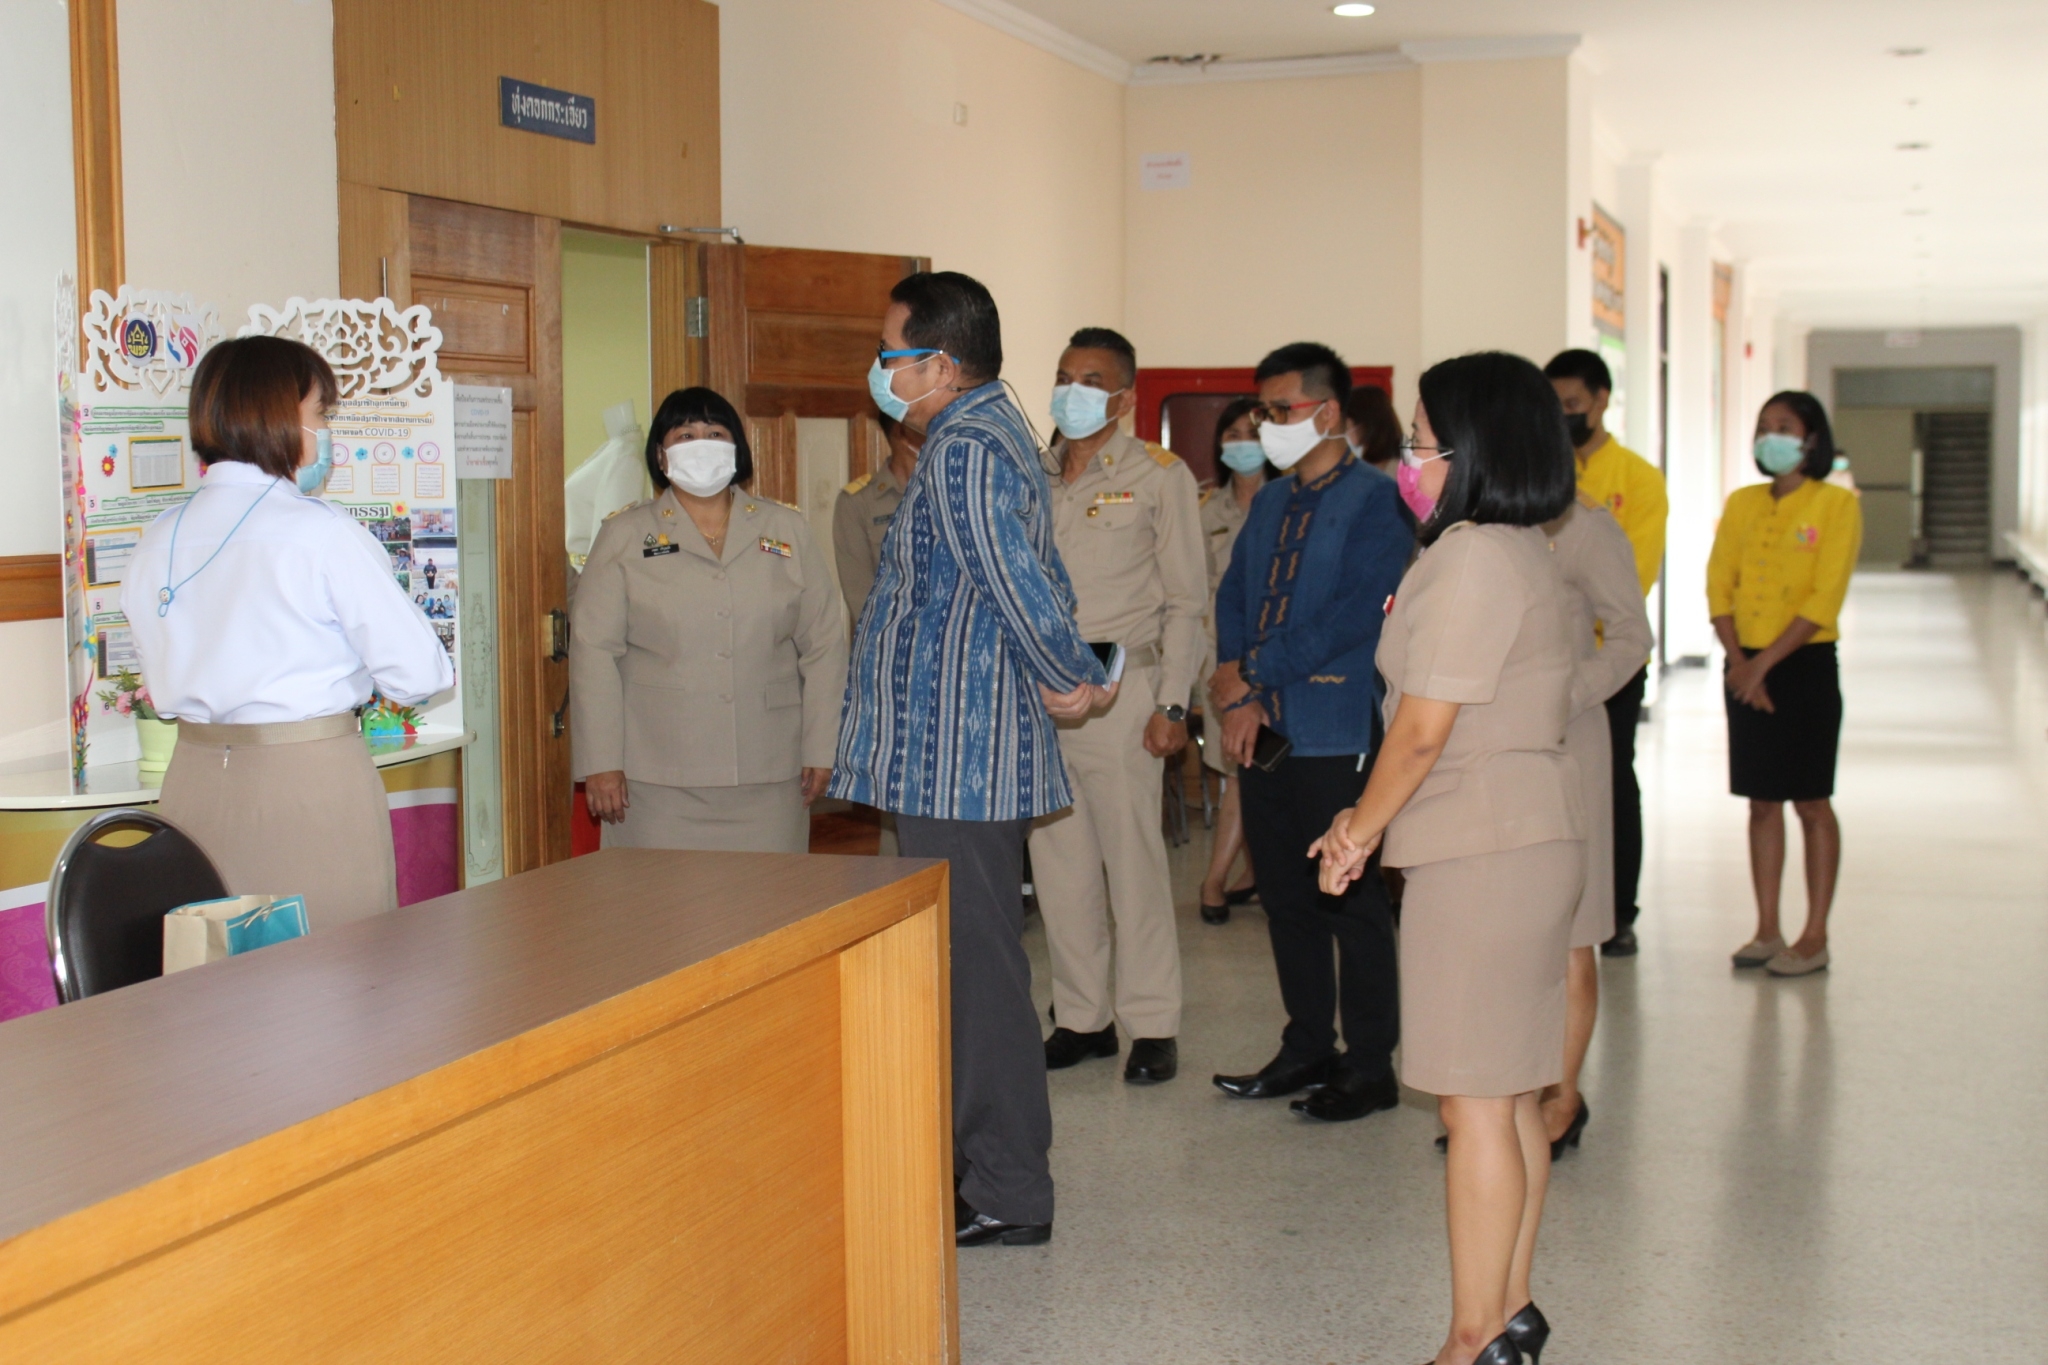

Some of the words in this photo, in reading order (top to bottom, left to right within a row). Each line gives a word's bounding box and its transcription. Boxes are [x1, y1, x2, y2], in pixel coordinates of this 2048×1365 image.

[511, 86, 587, 129] ทุ่งดอกกระเจียว
[84, 408, 89, 417] 2
[365, 428, 409, 437] COVID-19
[345, 506, 389, 518] กรรม
